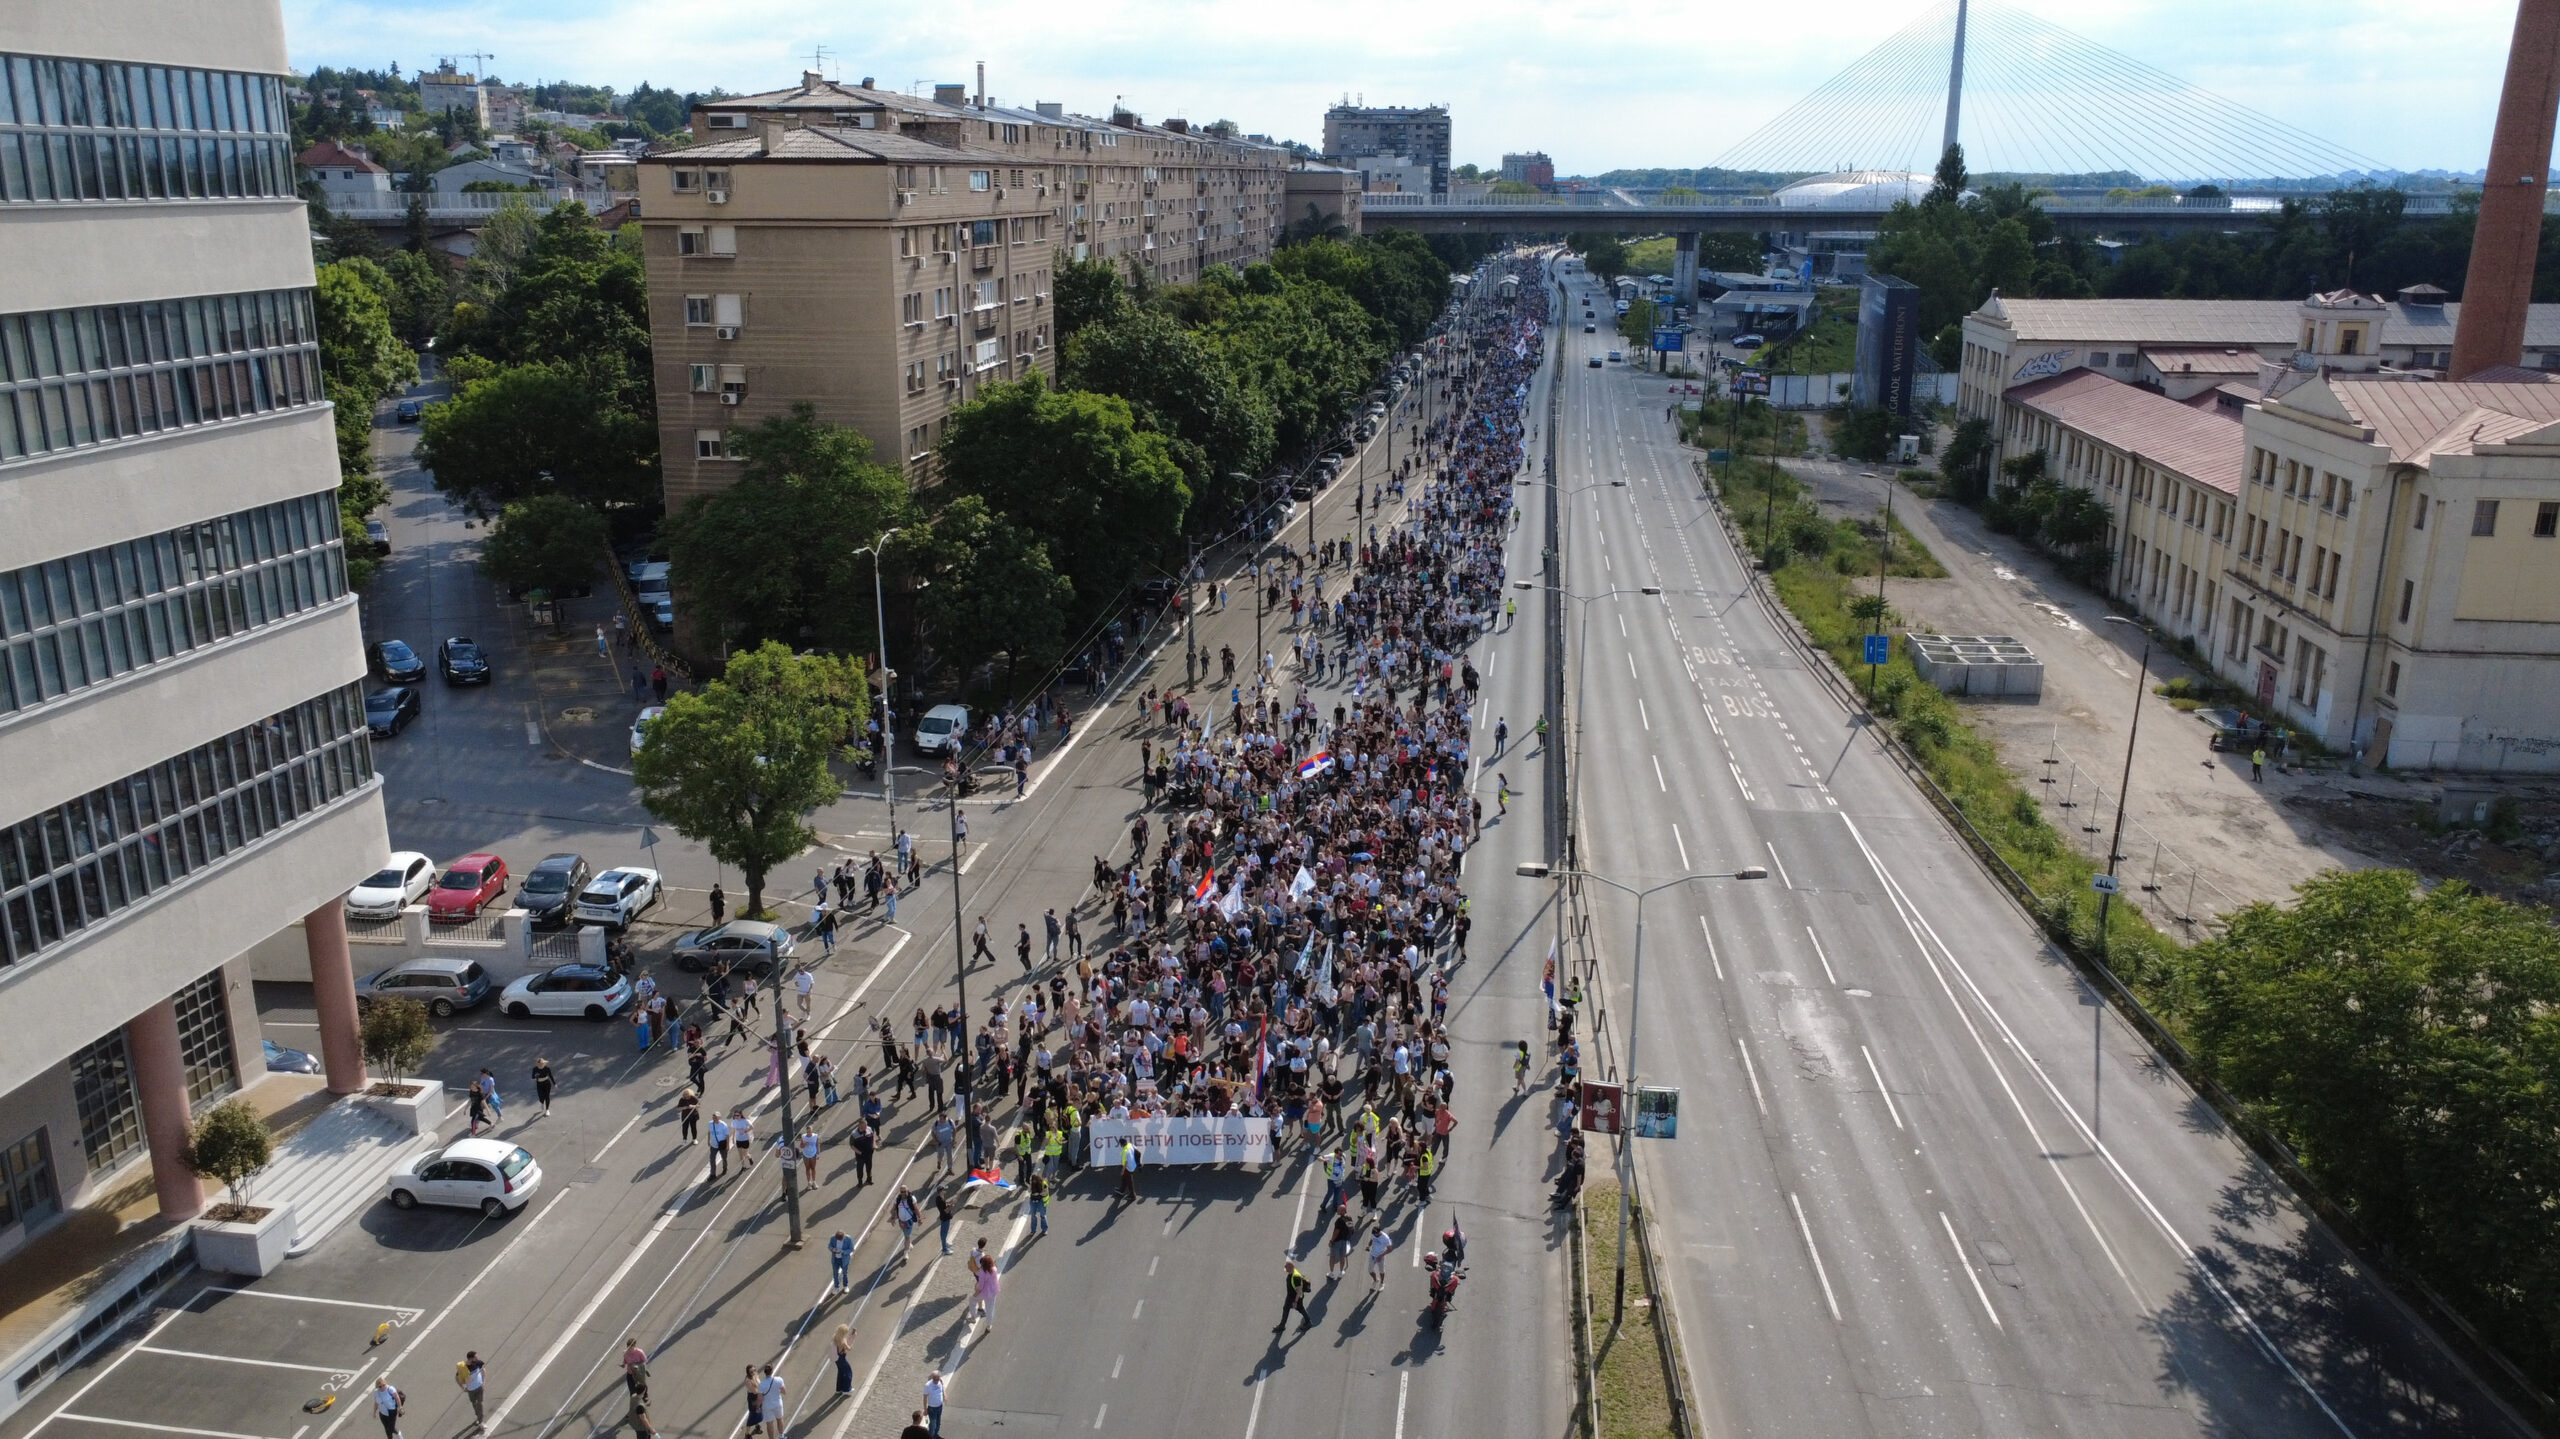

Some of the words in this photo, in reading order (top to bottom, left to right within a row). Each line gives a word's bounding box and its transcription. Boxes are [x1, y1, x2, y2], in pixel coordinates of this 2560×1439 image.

[1892, 306, 1907, 372] WATERFRONT
[1888, 376, 1901, 416] LGRADE
[1692, 646, 1732, 665] BUS
[1704, 677, 1750, 688] TAXI
[1721, 694, 1768, 718] BUS
[1586, 1104, 1616, 1113] MAO
[1642, 1111, 1673, 1119] MANGO
[1179, 1133, 1268, 1147] ПОБЕЂУЈУ!
[386, 1311, 413, 1328] 24
[320, 1373, 350, 1392] 23
